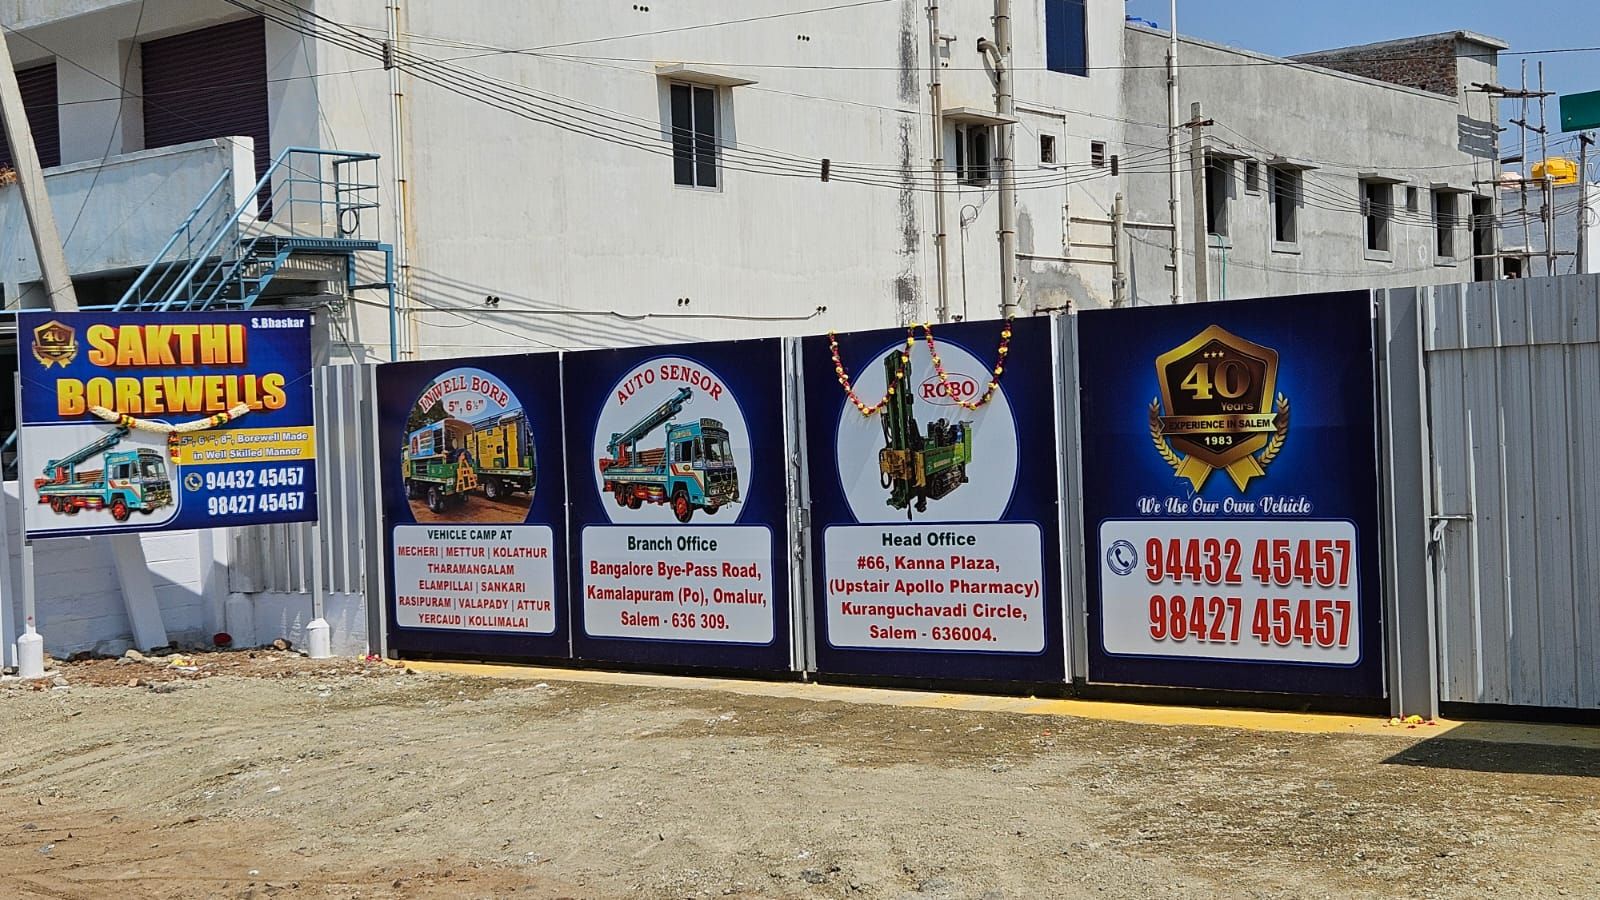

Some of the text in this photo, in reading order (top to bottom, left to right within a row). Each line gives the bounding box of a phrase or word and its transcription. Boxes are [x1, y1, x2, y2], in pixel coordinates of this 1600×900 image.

[251, 317, 305, 329] S.Bhaskar
[86, 323, 246, 367] SAKTHI
[616, 364, 723, 405] AUTO SENSOR
[1180, 359, 1251, 400] 40
[56, 373, 287, 416] BOREWELLS
[419, 375, 509, 413] INWELL BORE
[923, 380, 975, 398] ROBO
[1220, 401, 1254, 411] Years
[1169, 418, 1271, 430] EXPERIENCE IN SALEM
[237, 432, 280, 444] Borewell
[282, 431, 308, 441] Made
[1204, 435, 1233, 446] 1983
[193, 447, 302, 460] in Well Skilled Manner
[206, 467, 304, 490] 94432 45457
[208, 491, 304, 516] 98427 45457
[1138, 496, 1311, 514] We Use Our Own Vehicle
[427, 529, 512, 540] VEHICLE CAMP AT
[882, 531, 976, 546] Head Office
[398, 546, 438, 557] MECHERI
[446, 546, 485, 557] METTUR
[493, 547, 548, 558] KOLATHUR
[627, 535, 718, 552] Branch Office
[427, 563, 515, 575] THARAMANGALAM
[590, 560, 761, 581] Bangalore Bye-Pass Road,
[857, 556, 1000, 572] #66, Kanna Plaza,
[1145, 537, 1352, 588] 94432 45457
[419, 579, 473, 592] ELAMPILLAI
[481, 581, 526, 593] SANKARI
[829, 578, 1039, 598] (Upstair Apollo Pharmacy)
[399, 596, 451, 608] RASIPURAM
[458, 598, 509, 610] VALAPADY
[516, 600, 551, 611] ATTUR
[587, 585, 767, 607] Kamalapuram (Po), Omalur,
[841, 601, 1028, 621] Kuranguchavadi Circle,
[419, 613, 461, 625] YERCAUD
[468, 615, 529, 628] KOLLIMALAI
[621, 611, 660, 627] Salem
[671, 612, 696, 628] 636
[700, 613, 729, 629] 309.
[1149, 594, 1352, 649] 98427 45457
[869, 625, 917, 640] Salem
[931, 626, 997, 641] 636004.
